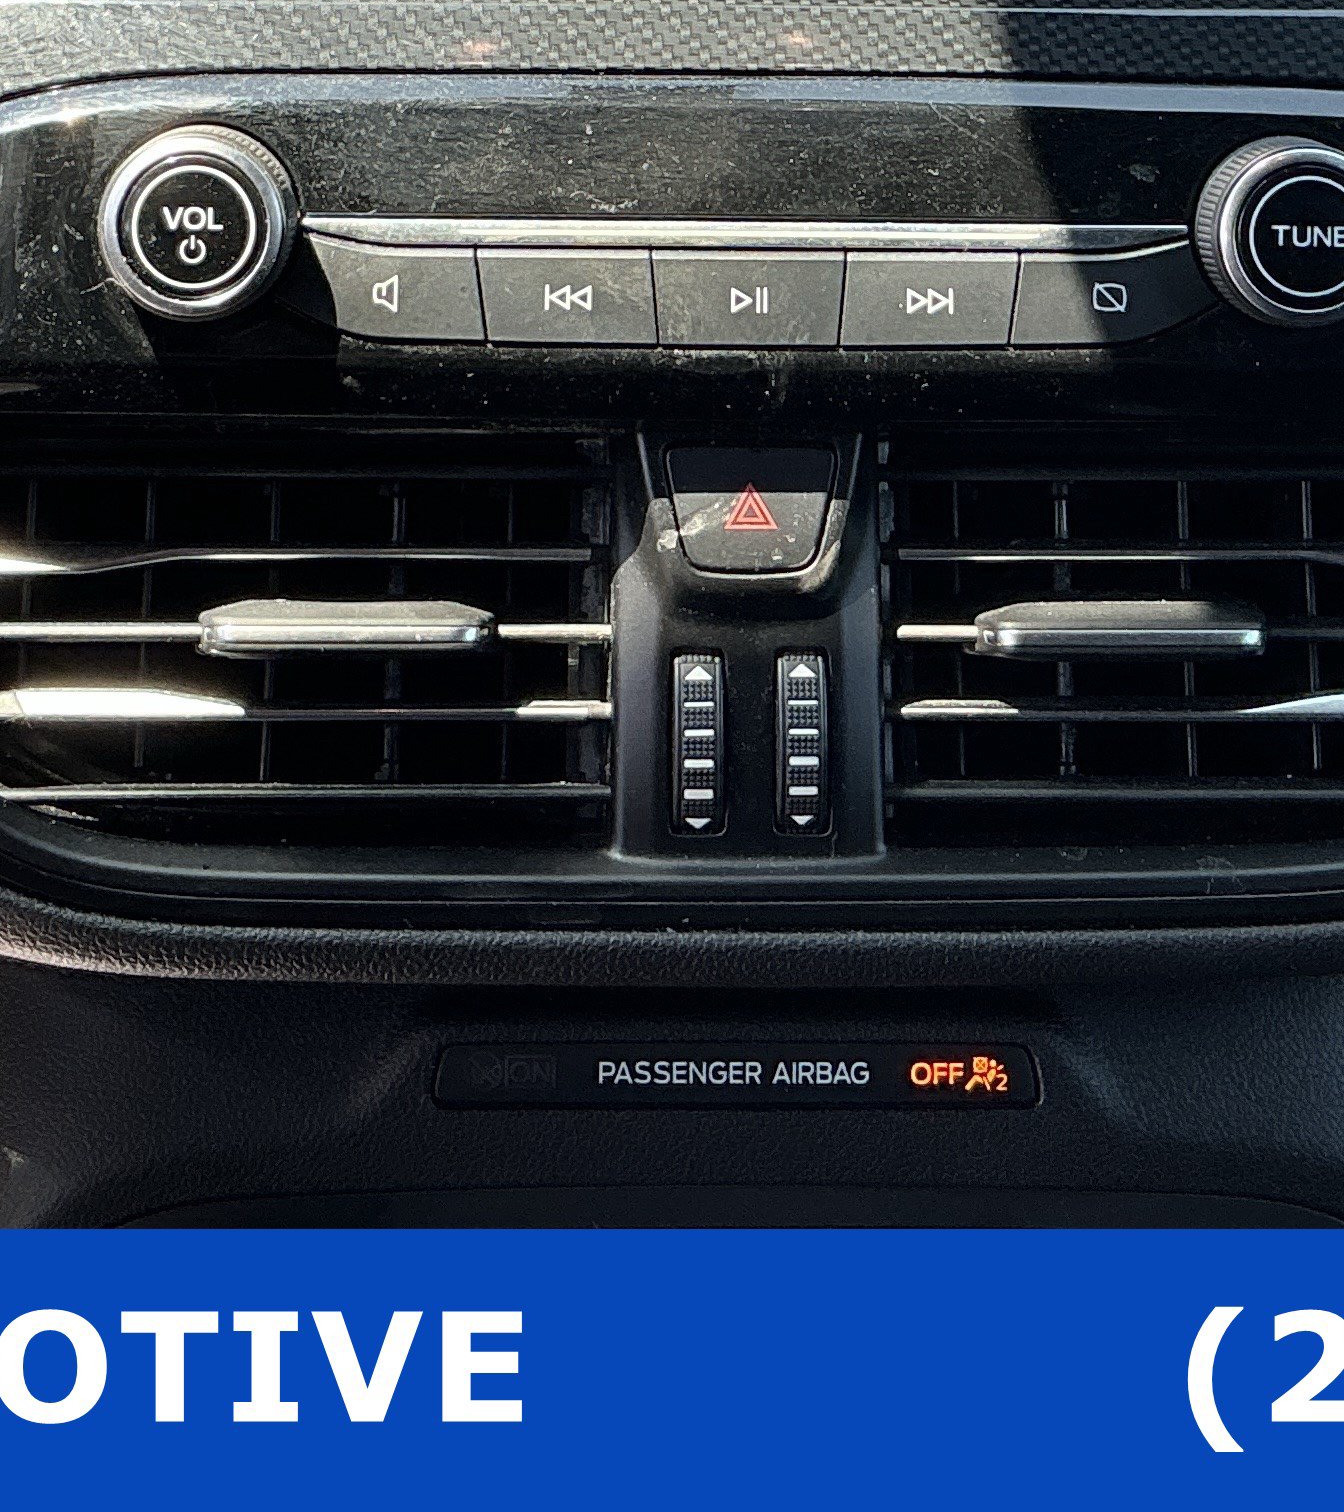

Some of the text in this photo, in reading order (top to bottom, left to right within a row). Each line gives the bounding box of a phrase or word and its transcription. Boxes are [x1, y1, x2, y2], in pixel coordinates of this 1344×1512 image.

[161, 206, 224, 231] VOL
[598, 1060, 870, 1085] PASSENGER AIRBAG
[910, 1061, 965, 1085] OFF
